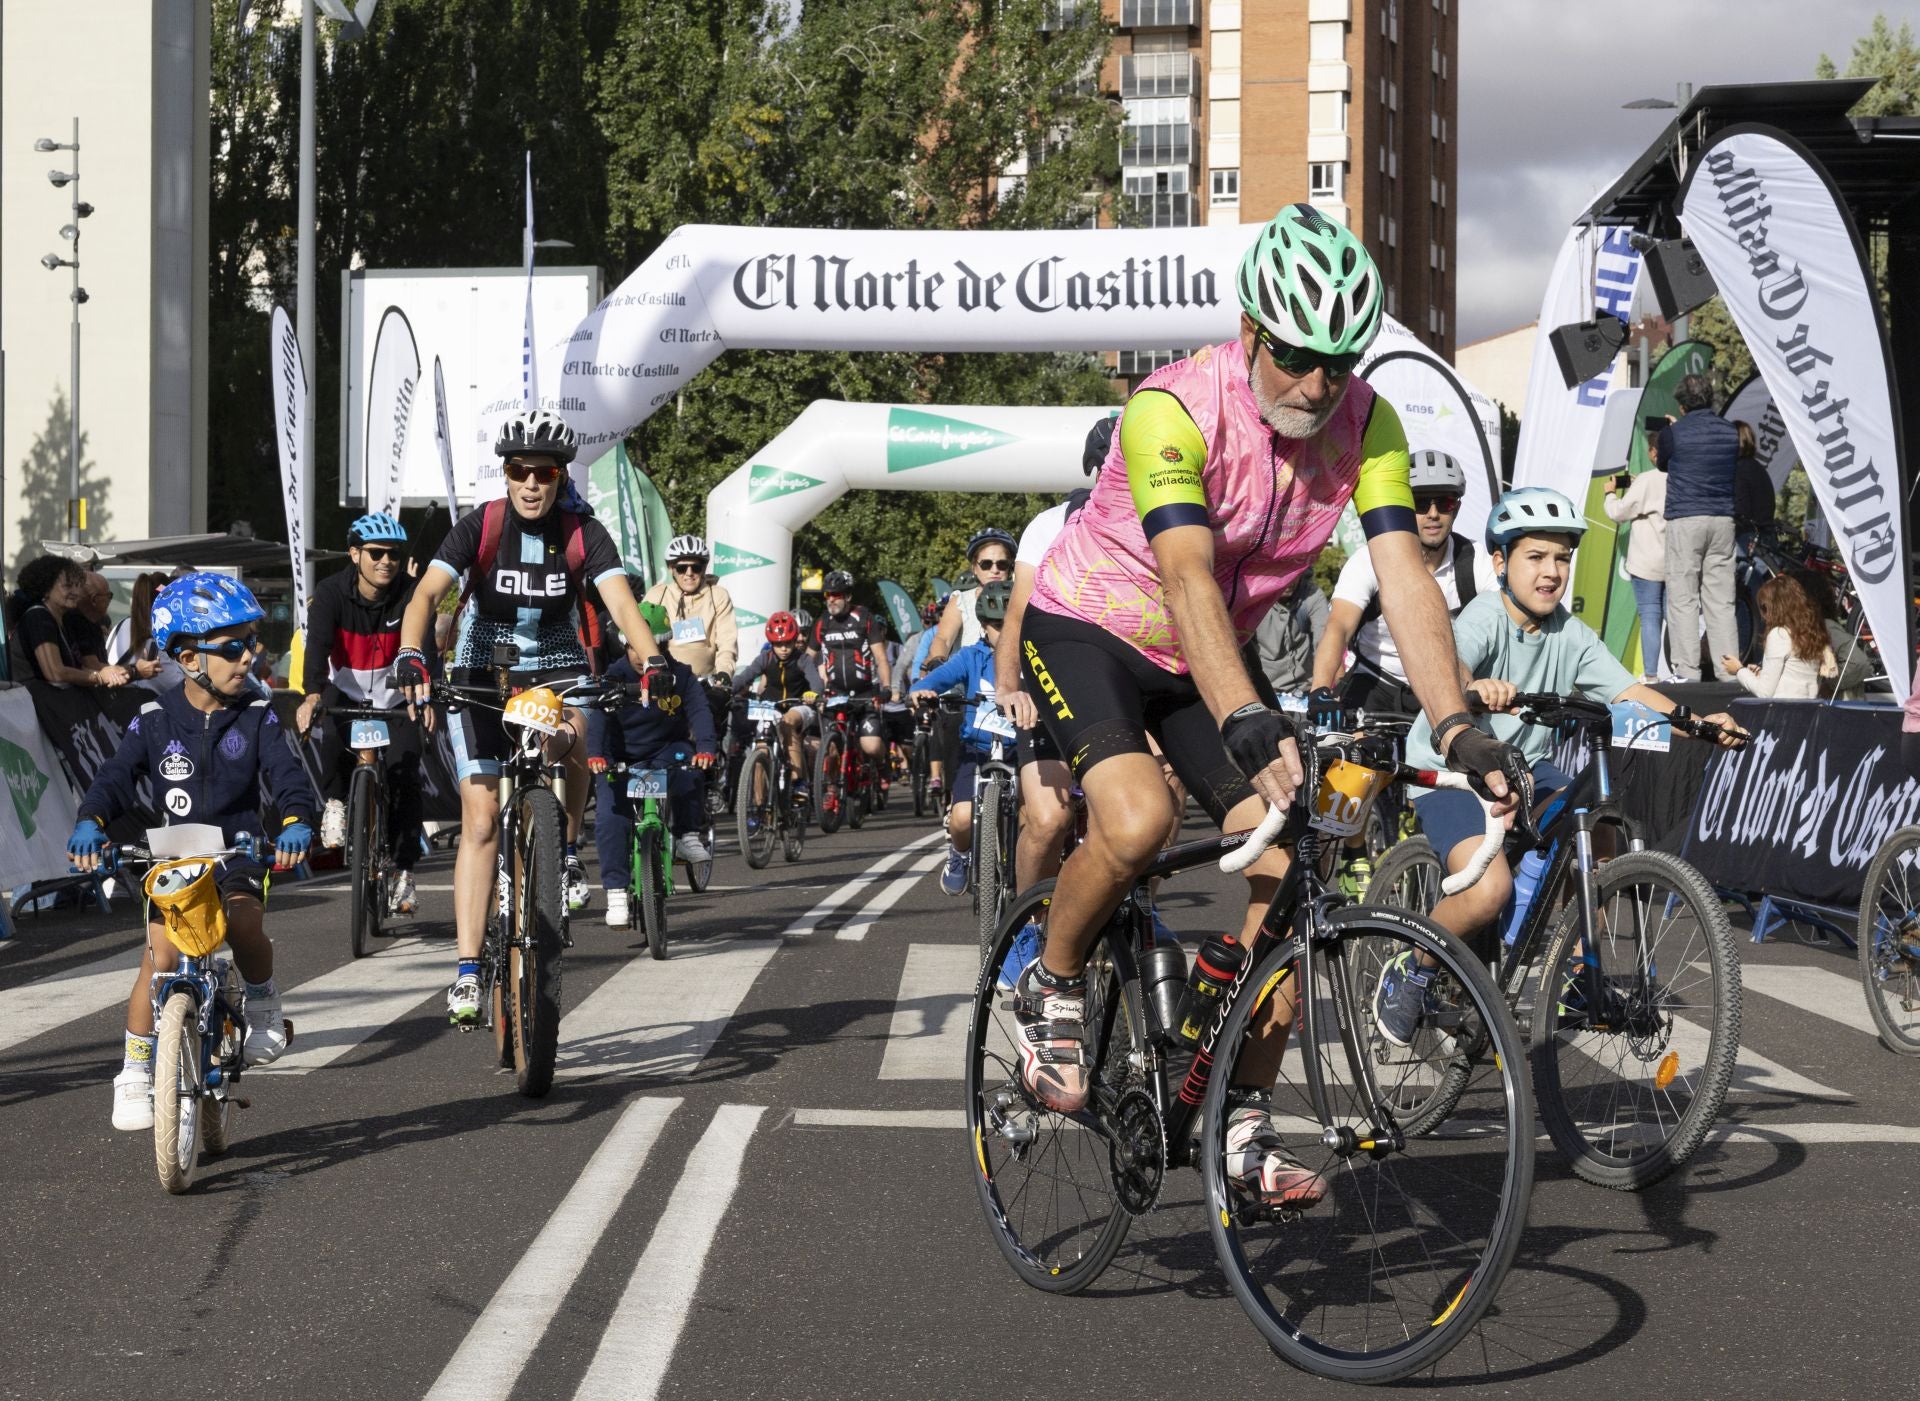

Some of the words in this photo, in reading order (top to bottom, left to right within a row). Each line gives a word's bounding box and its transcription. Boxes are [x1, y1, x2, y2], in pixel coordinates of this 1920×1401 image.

[733, 253, 798, 312] El
[807, 254, 944, 312] Norte
[953, 260, 1006, 312] de
[1015, 254, 1222, 313] Castilla
[637, 291, 687, 307] Castilla
[659, 328, 677, 344] El
[679, 328, 713, 343] Norte
[562, 361, 579, 376] El
[581, 361, 615, 377] Norte
[617, 362, 631, 378] de
[631, 363, 680, 378] Castilla
[1149, 475, 1201, 489] Valladolid
[679, 627, 699, 639] 493
[1023, 640, 1074, 720] SCOTT
[512, 699, 560, 726] 1095
[357, 729, 383, 744] 310
[1623, 717, 1660, 741] 198
[170, 795, 188, 810] JD
[1731, 729, 1808, 849] Norte
[1791, 747, 1841, 860] de
[1547, 936, 1564, 968] TERRAIN
